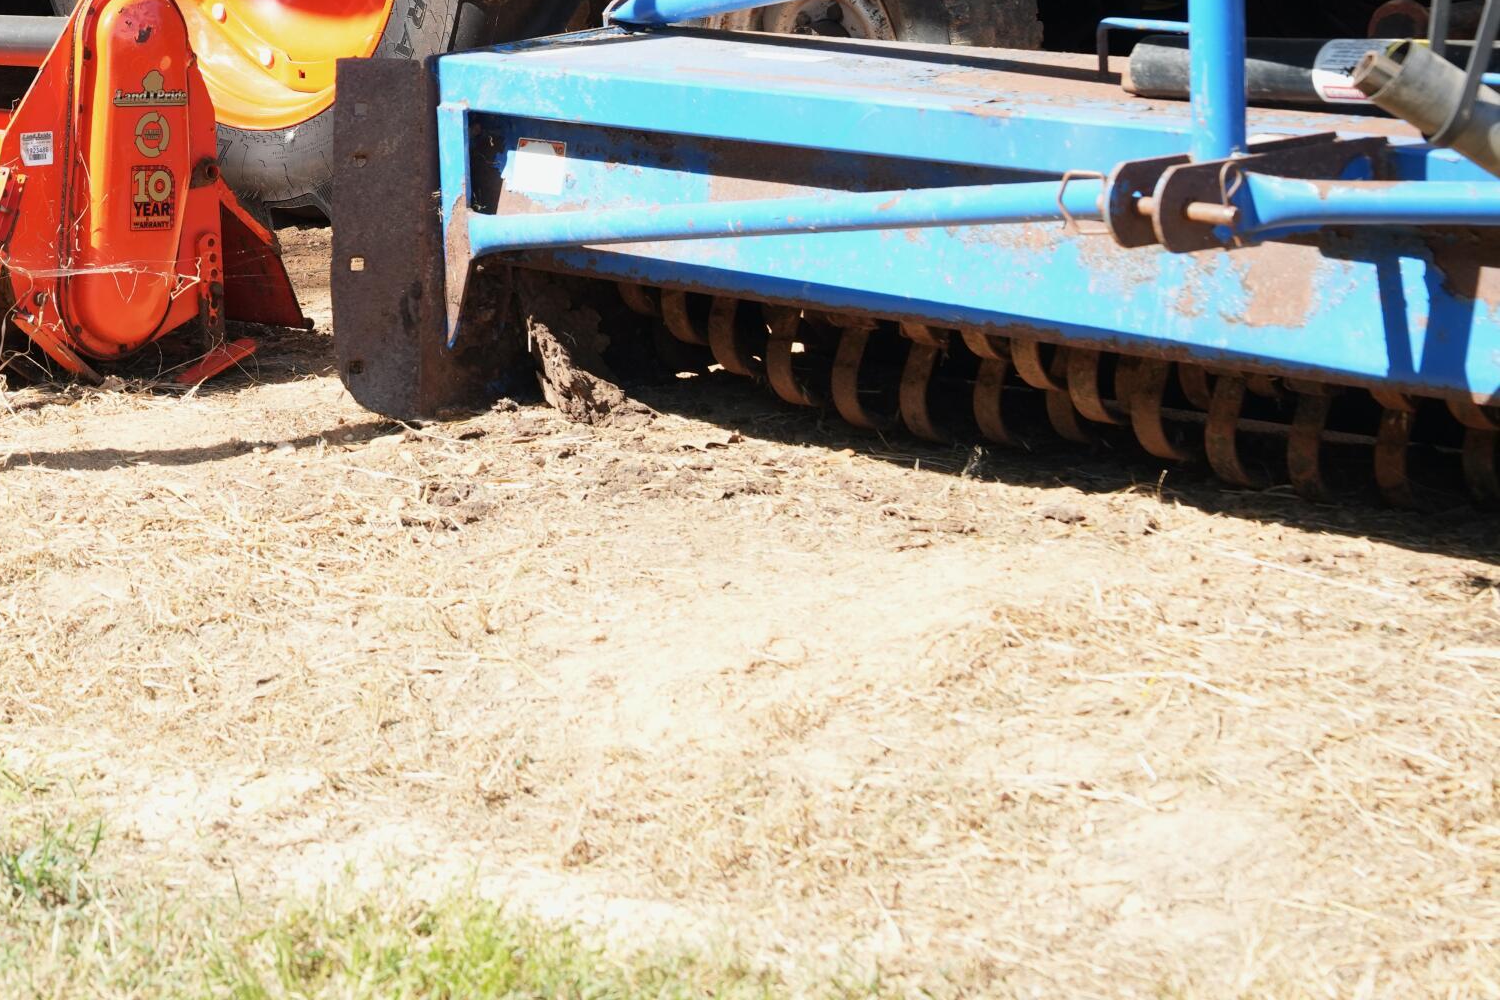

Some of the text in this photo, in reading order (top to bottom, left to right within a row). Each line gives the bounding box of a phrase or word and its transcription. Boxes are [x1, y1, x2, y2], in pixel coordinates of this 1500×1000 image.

[114, 88, 187, 101] Land Pride
[133, 170, 172, 202] 10
[134, 202, 171, 216] YEAR
